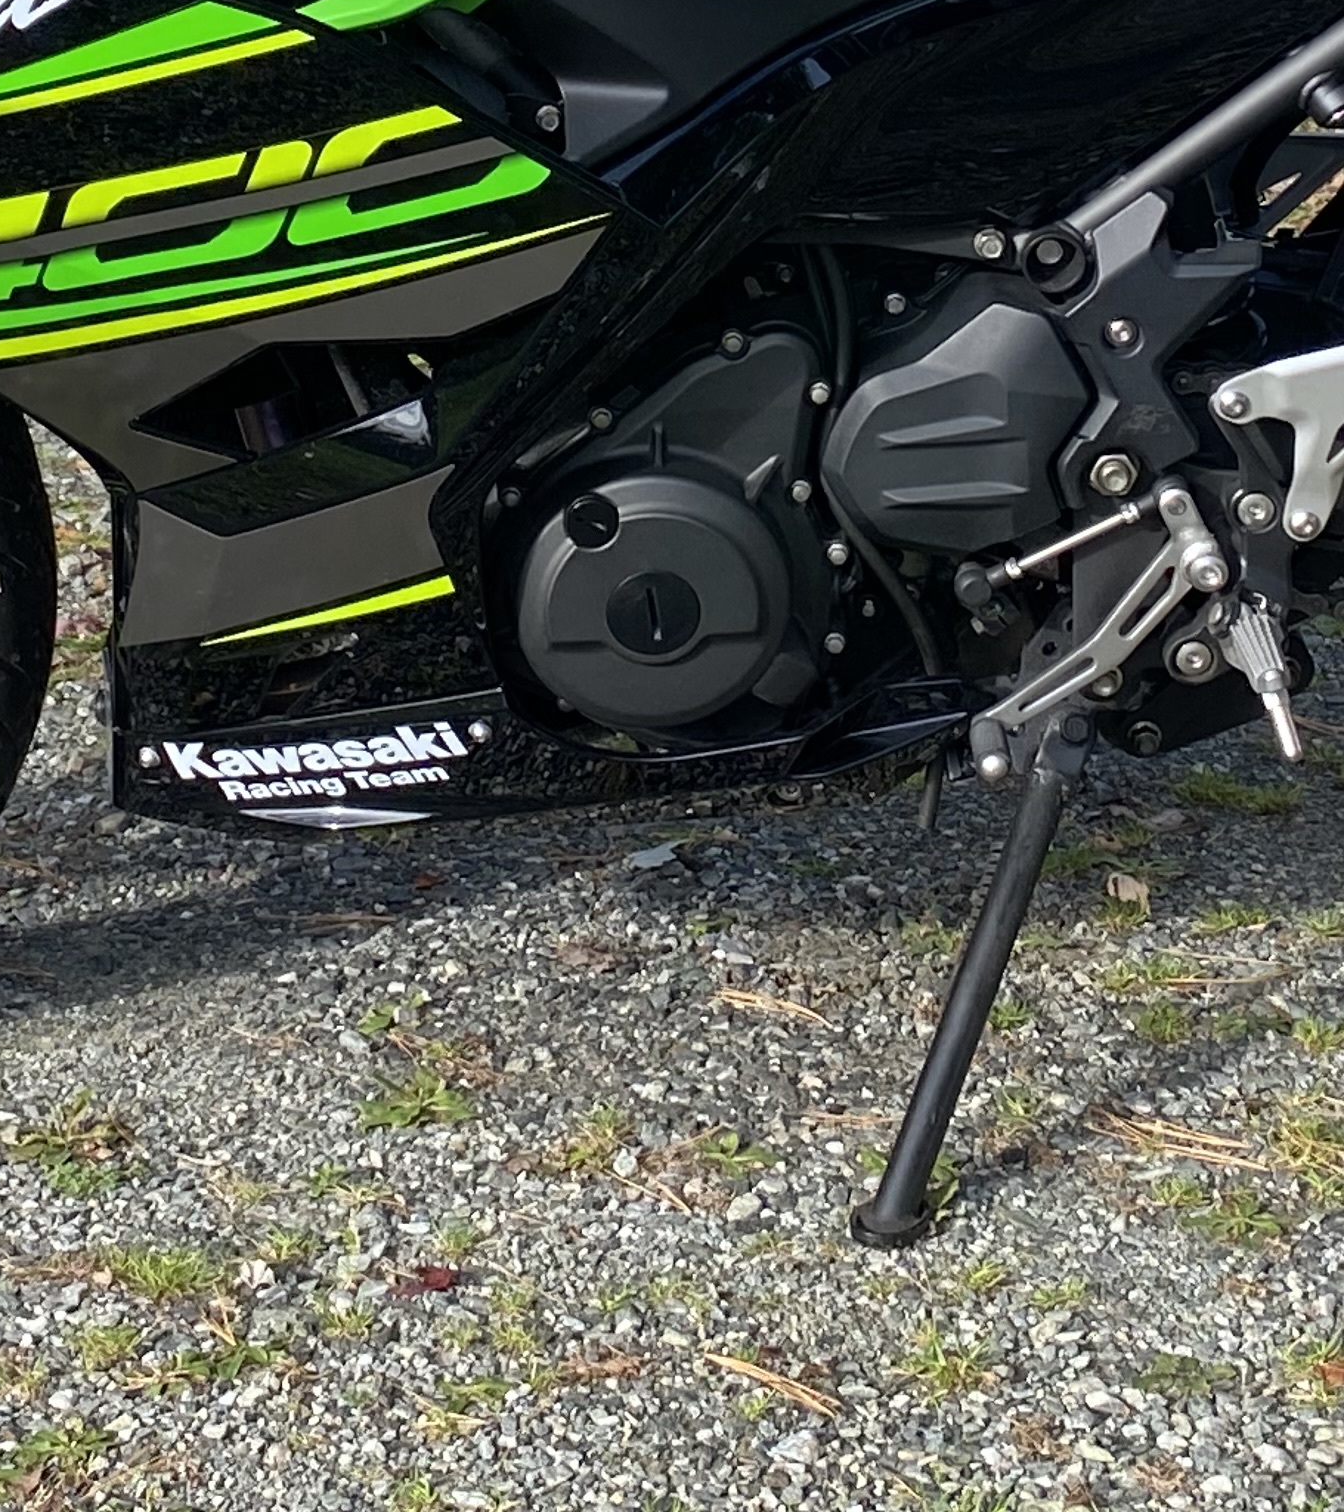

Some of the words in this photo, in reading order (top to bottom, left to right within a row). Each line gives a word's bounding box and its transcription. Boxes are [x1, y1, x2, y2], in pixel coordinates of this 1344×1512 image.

[162, 720, 471, 780] Kawasaki
[218, 774, 348, 802] Racing
[343, 765, 451, 791] Team
